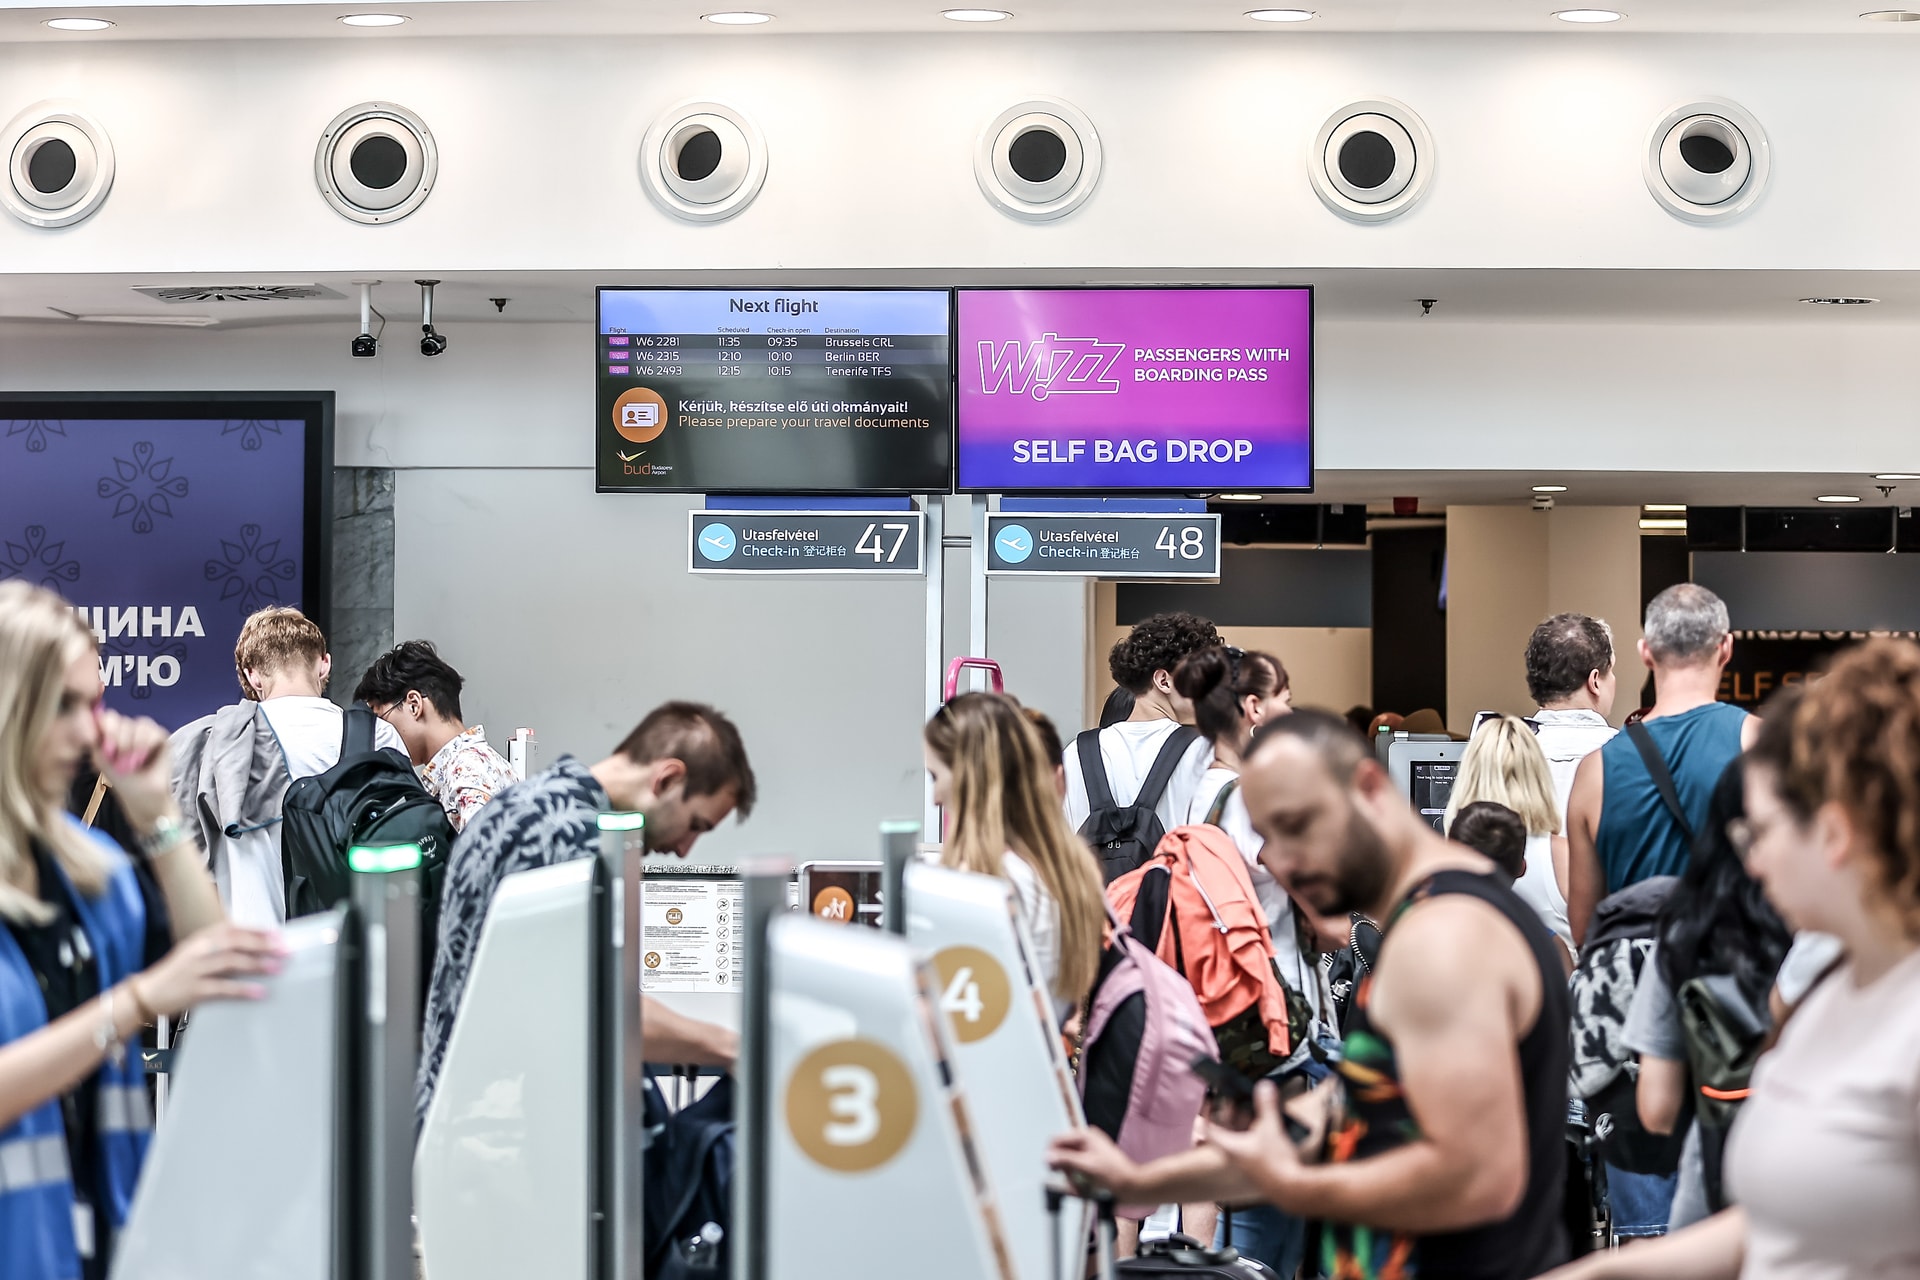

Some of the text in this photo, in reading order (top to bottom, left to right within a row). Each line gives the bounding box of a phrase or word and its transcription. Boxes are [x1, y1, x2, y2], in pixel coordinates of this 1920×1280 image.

[730, 298, 819, 316] Next flight
[636, 337, 654, 346] W6
[656, 337, 680, 346] 2281
[718, 337, 741, 346] 11:35
[767, 337, 798, 346] 09:35
[825, 338, 894, 346] Brussels CRL
[636, 352, 654, 361] W6
[656, 352, 680, 361] 2315
[718, 352, 742, 361] 12:10
[767, 352, 793, 361] 10:10
[825, 352, 880, 362] Berlin BER
[1134, 348, 1290, 361] PASSENGERS WITH
[636, 366, 654, 375] W6
[656, 366, 682, 375] 2493
[718, 366, 741, 375] 12:15
[767, 366, 792, 375] 10:15
[825, 366, 892, 376] Tenerife TFS
[1134, 368, 1268, 381] BOARDING PASS
[679, 399, 908, 415] Kérjük, készítse elő úti okmányait!
[679, 415, 929, 430] Please prepare your travel documents
[1013, 440, 1253, 463] SELF BAG DROP
[624, 462, 651, 475] bud
[742, 529, 819, 541] Utasfelvétel
[1039, 530, 1119, 543] Utasfelvétel
[854, 523, 910, 563] 47
[1154, 526, 1204, 560] 48
[742, 545, 800, 557] Check-in
[1038, 546, 1098, 558] Check-in
[1100, 548, 1140, 560] 登记柜台
[942, 967, 983, 1022] 4
[820, 1064, 881, 1146] 3
